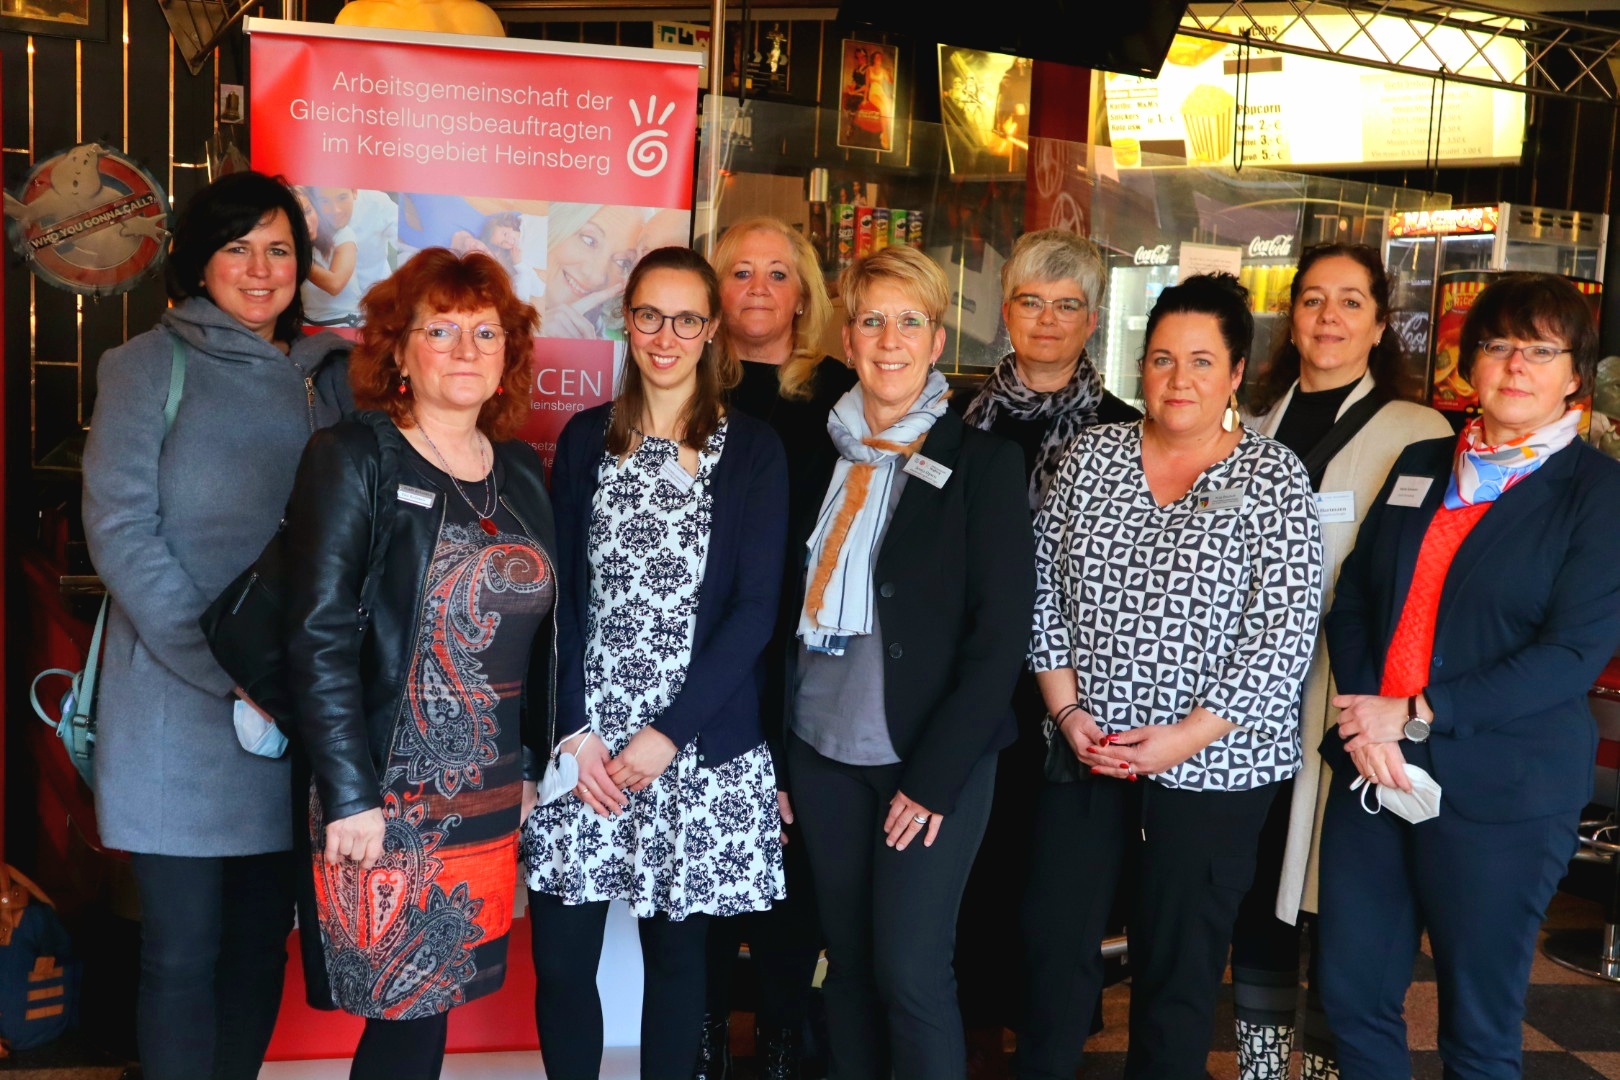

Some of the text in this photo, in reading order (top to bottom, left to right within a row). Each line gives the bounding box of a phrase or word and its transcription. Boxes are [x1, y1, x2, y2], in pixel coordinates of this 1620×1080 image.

[332, 71, 613, 111] Arbeitsgemeinschaft der
[290, 98, 611, 144] Gleichstellungsbeauftragten
[1236, 104, 1281, 116] Popcorn
[322, 132, 611, 176] im Kreisgebiet Heinsberg
[31, 195, 154, 248] WHO YOU GONNA CALL?
[1403, 207, 1484, 234] NACHOS
[1248, 233, 1294, 258] Coca-Cola
[529, 367, 602, 397] CEN
